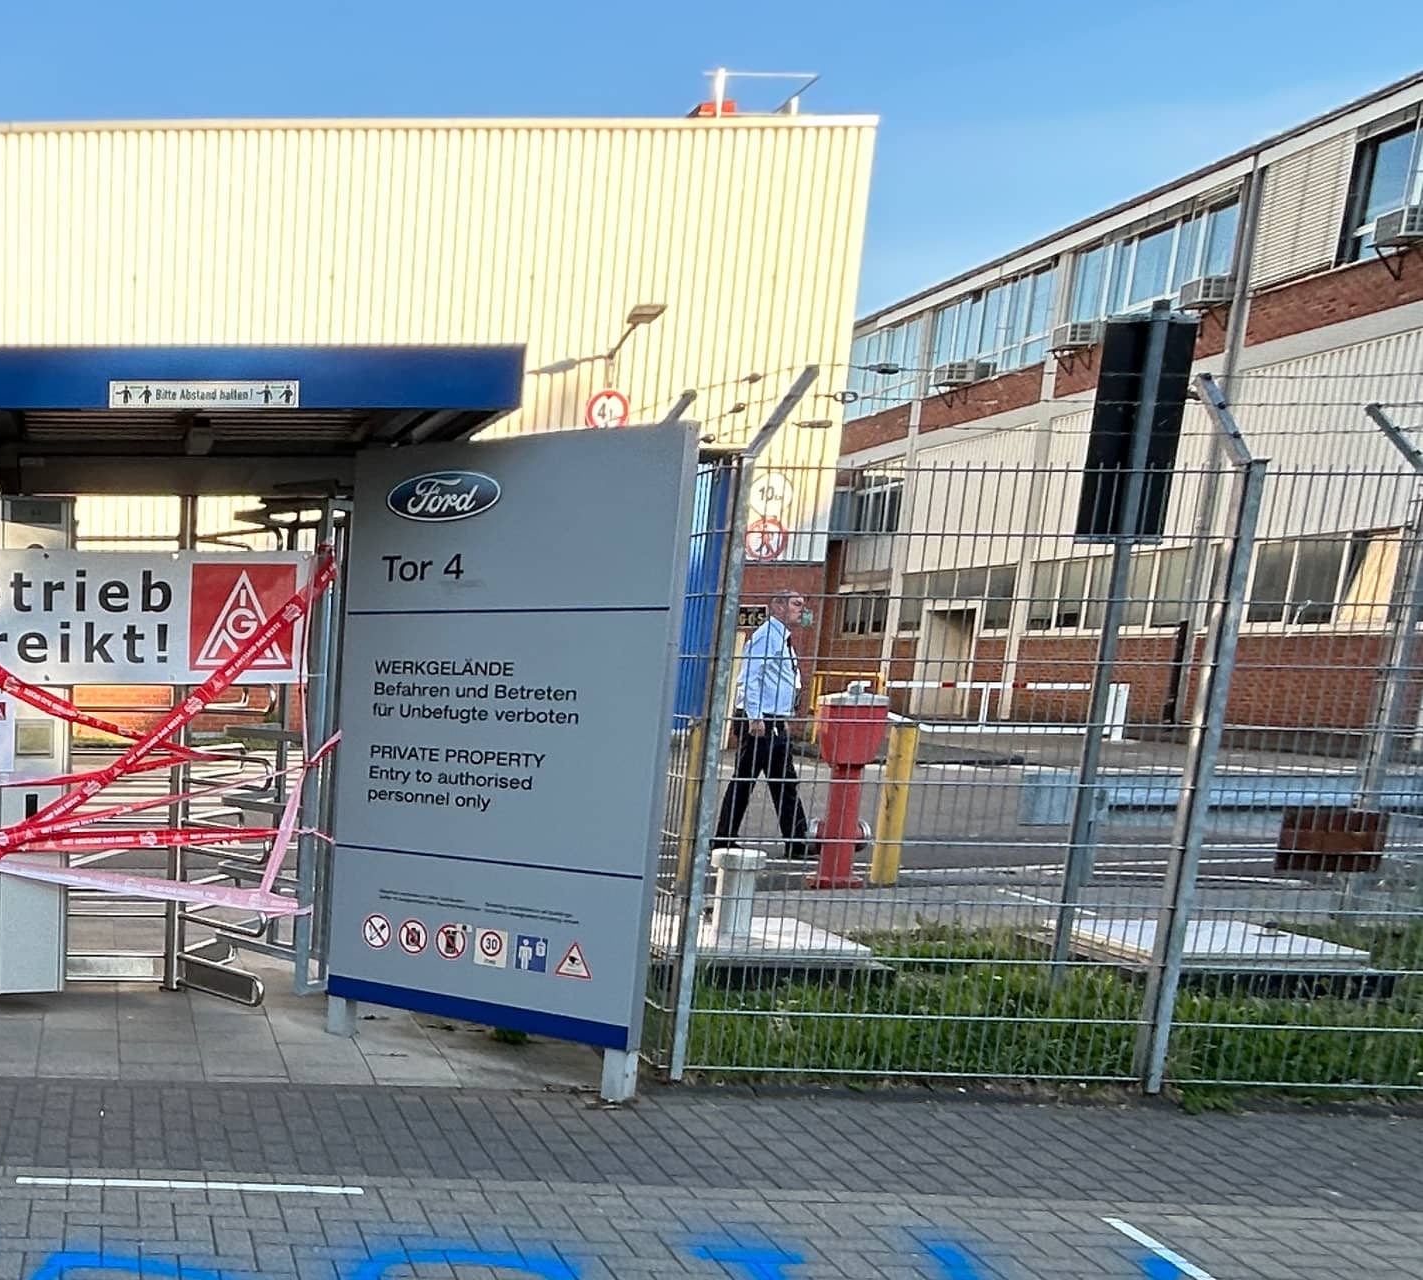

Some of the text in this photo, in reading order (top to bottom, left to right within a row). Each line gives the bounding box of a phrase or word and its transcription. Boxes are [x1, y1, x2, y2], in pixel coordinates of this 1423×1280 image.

[155, 388, 176, 400] Bitte
[180, 388, 217, 400] Abstand
[407, 478, 479, 513] Ford
[382, 553, 464, 582] Tor 4
[375, 658, 514, 676] WERKGELÄNDE
[374, 682, 577, 701] Befahren und Betreten
[373, 703, 579, 724] für Unbefugte verboten
[370, 745, 545, 768] PRIVATE PROPERTY
[369, 766, 533, 790] Entry to authorised
[368, 789, 491, 812] personnel only
[485, 938, 498, 950] 30
